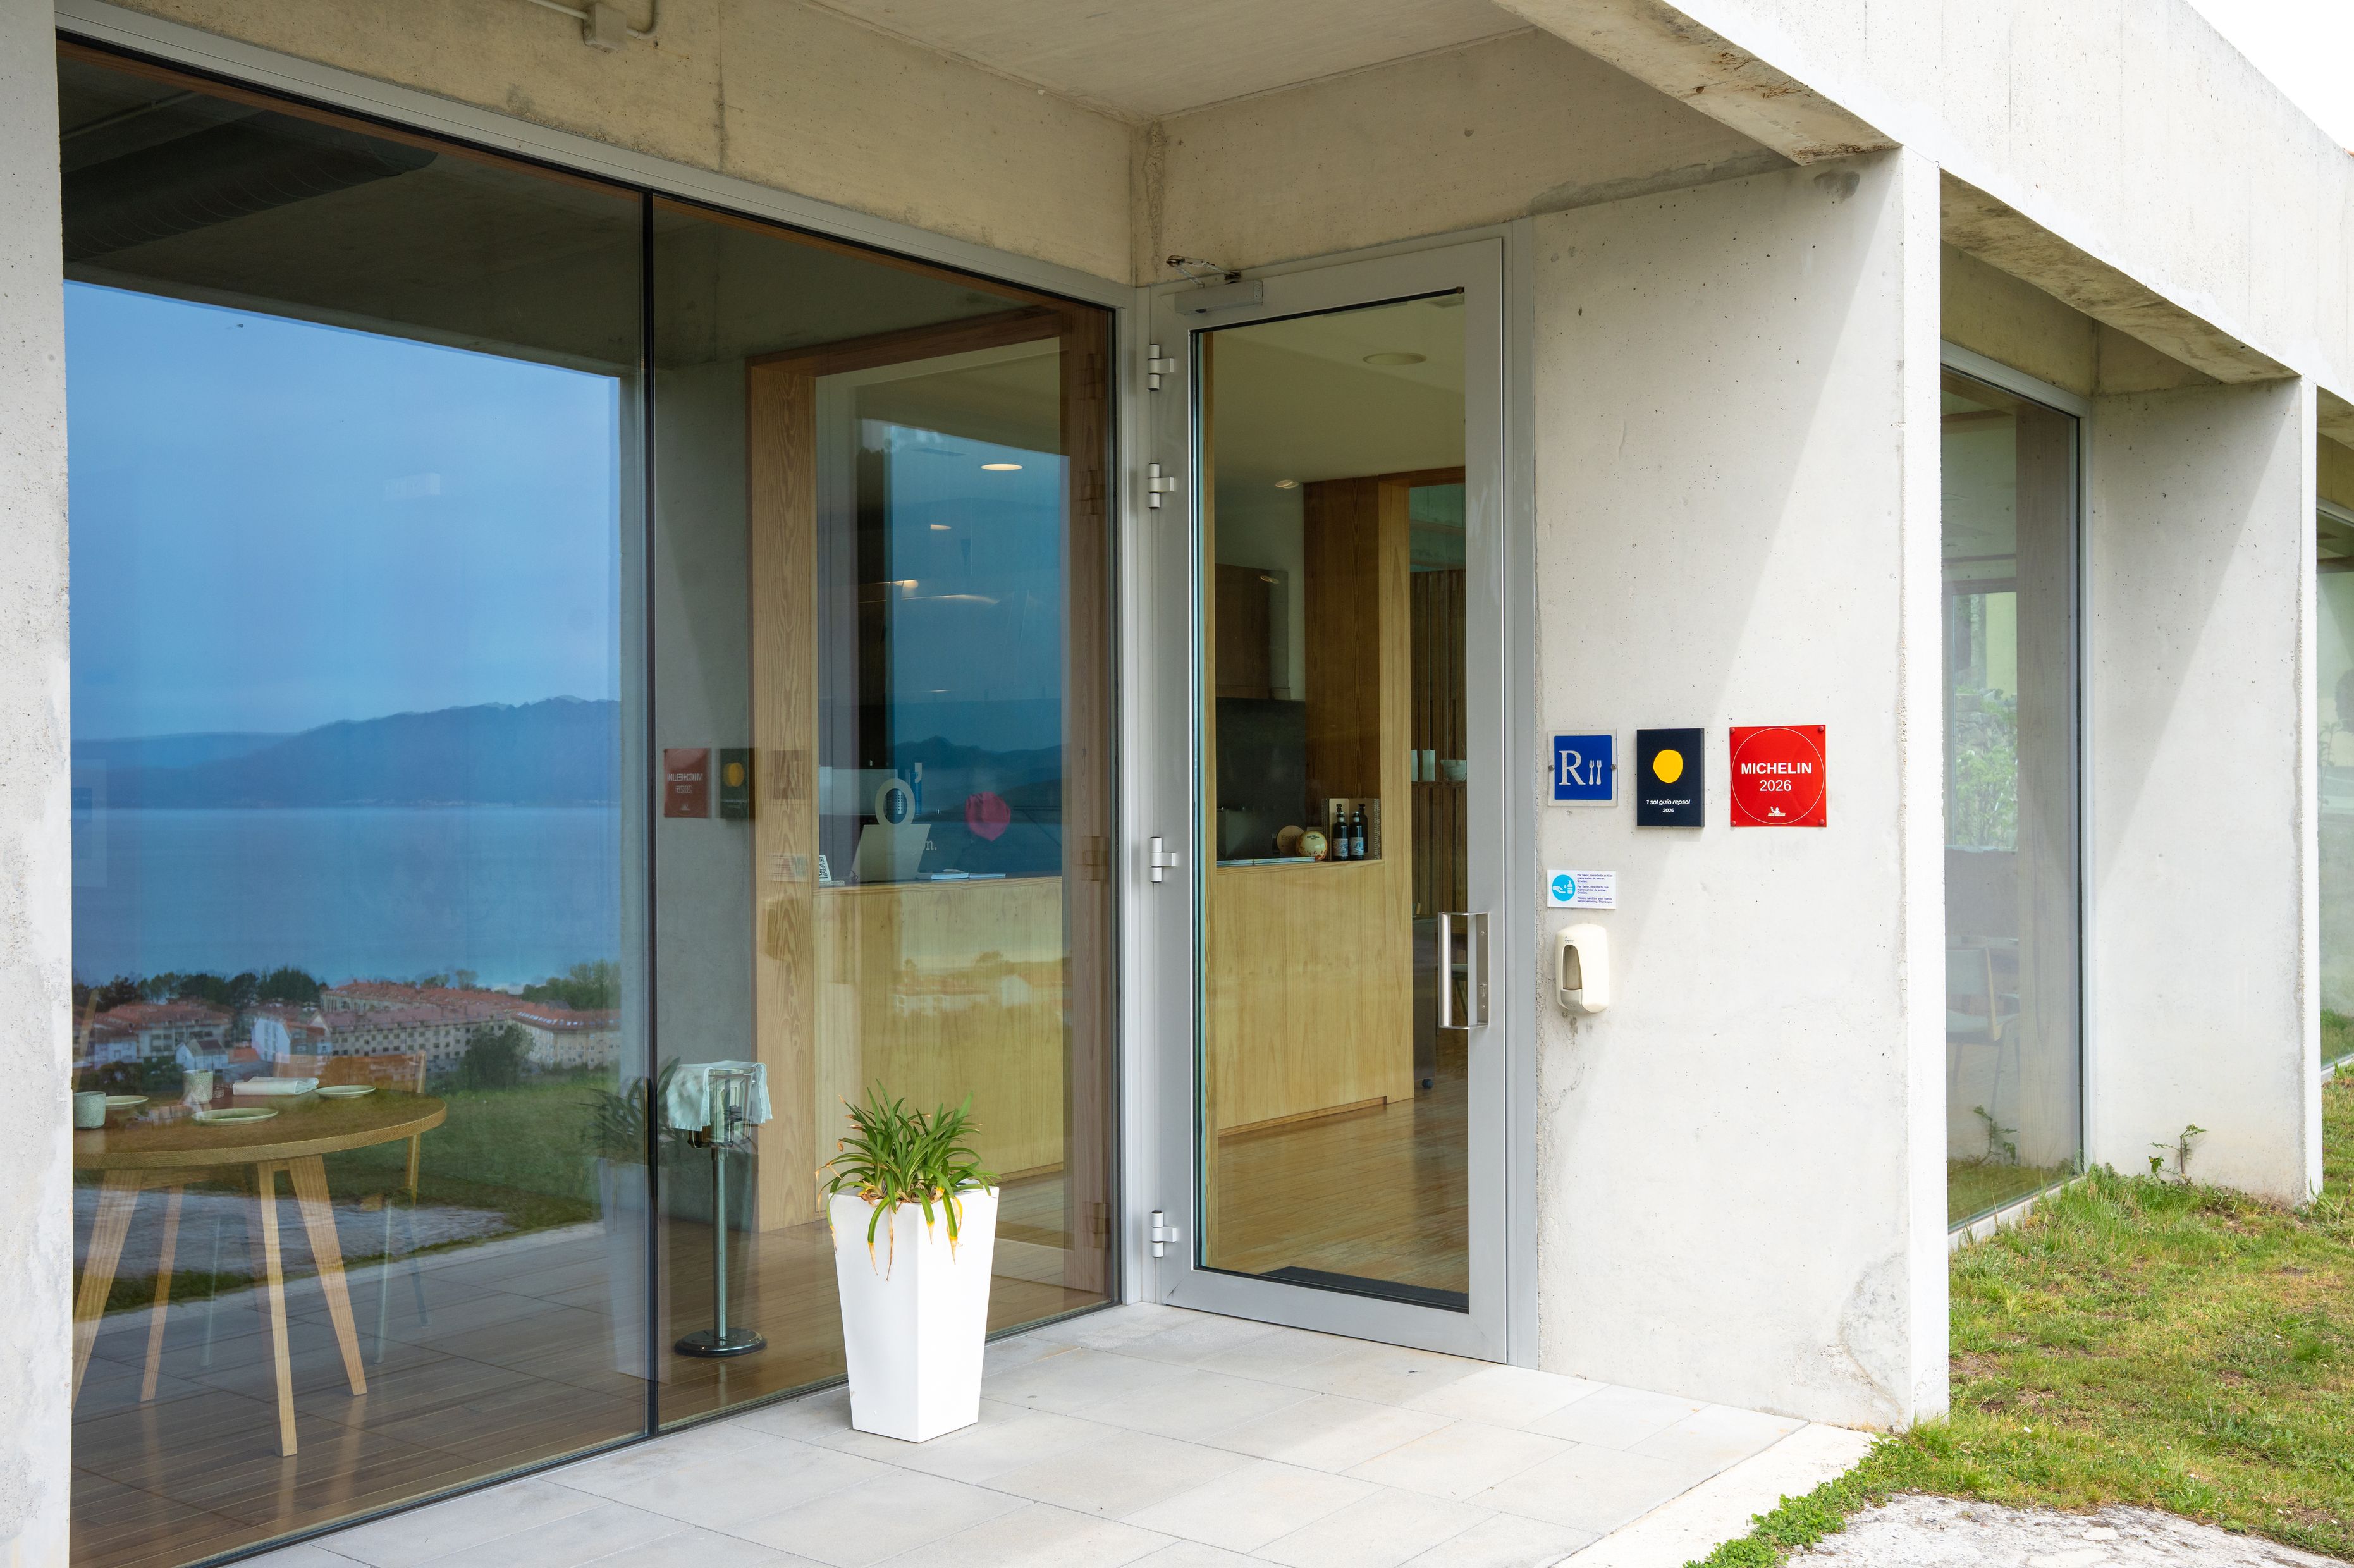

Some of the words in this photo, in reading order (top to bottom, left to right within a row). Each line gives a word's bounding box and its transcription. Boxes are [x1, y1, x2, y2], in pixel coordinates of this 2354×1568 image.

[1559, 750, 1586, 785] R
[1741, 762, 1812, 775] MICHELIN
[1760, 780, 1792, 792] 2026
